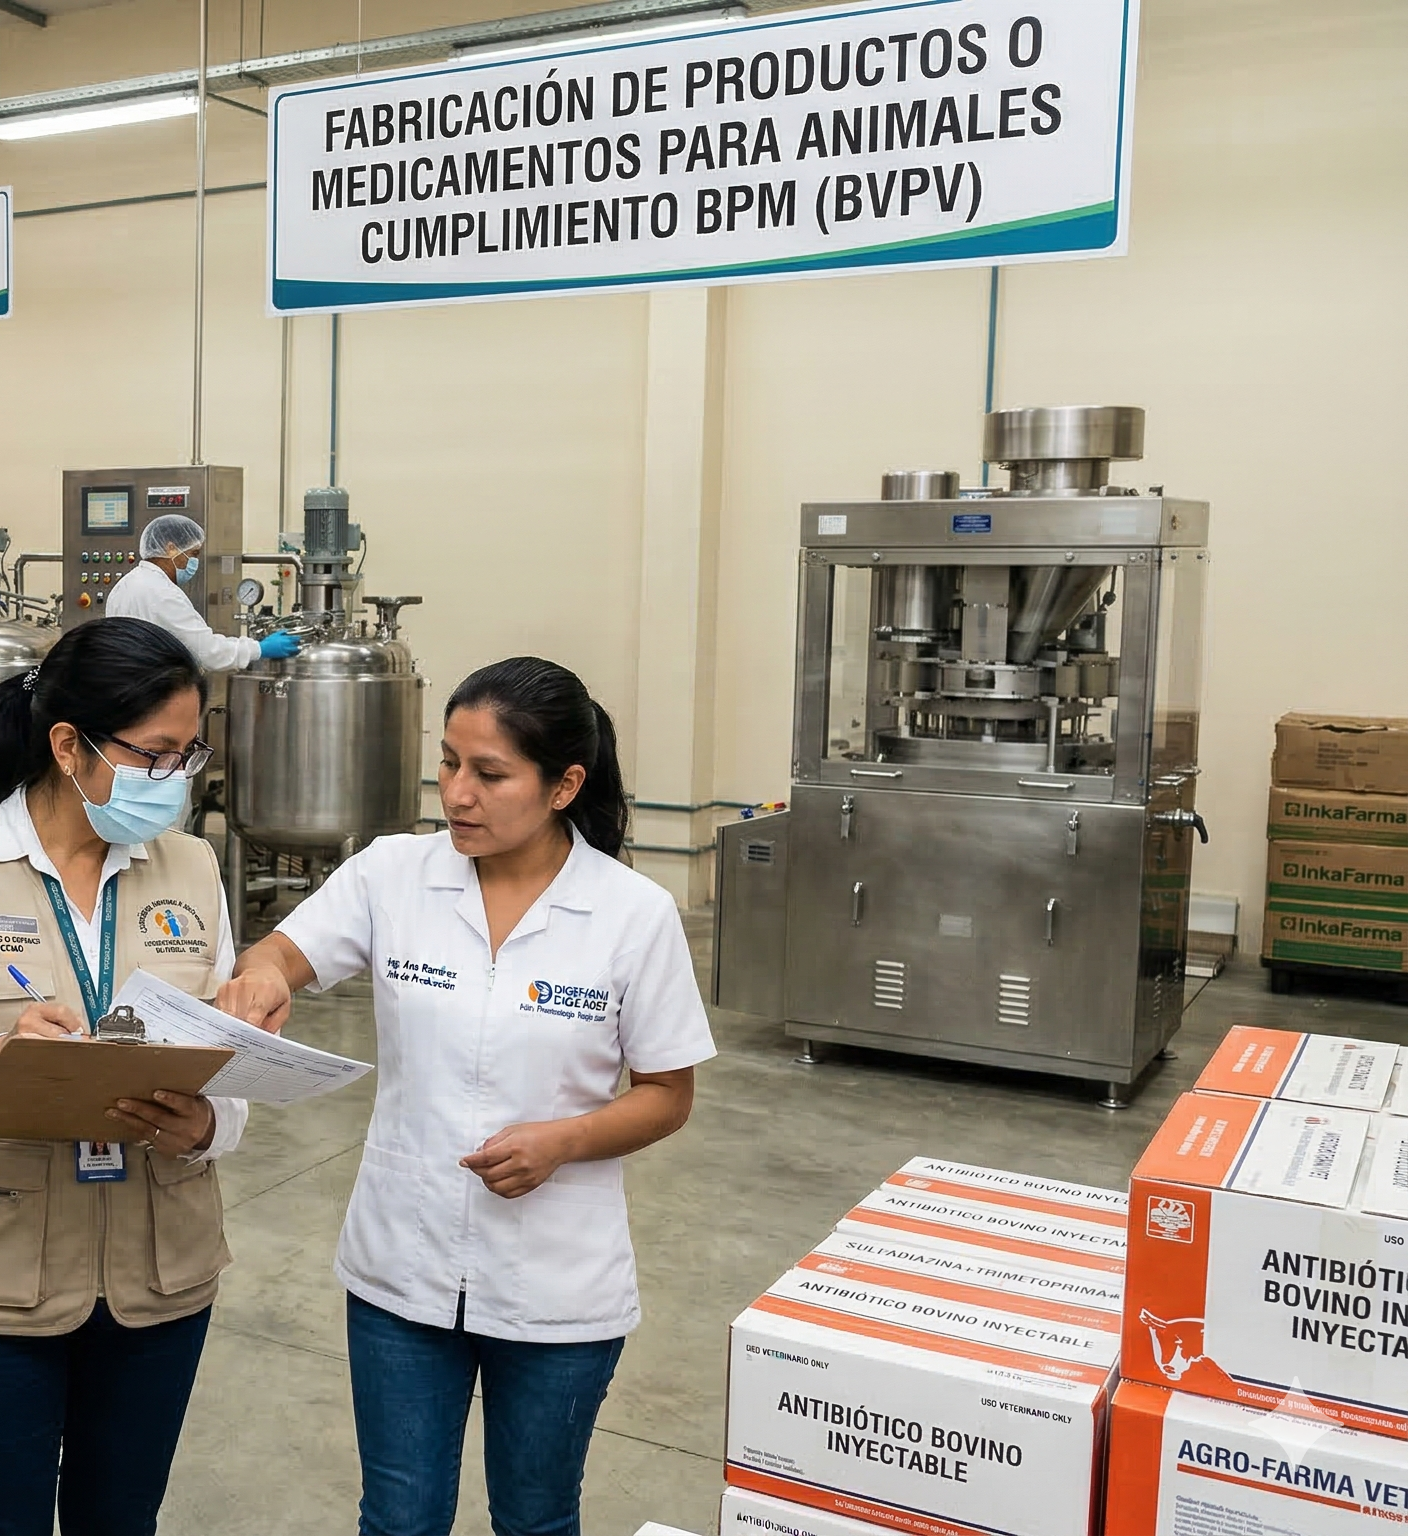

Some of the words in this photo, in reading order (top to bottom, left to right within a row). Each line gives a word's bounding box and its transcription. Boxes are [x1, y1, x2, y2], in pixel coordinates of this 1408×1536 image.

[325, 68, 593, 153] FABRICACIÓN
[612, 66, 668, 117] DE
[685, 23, 987, 108] PRODUCTOS
[1008, 16, 1043, 68] O
[312, 133, 640, 211] MEDICAMENTOS
[659, 117, 781, 175] PARA
[796, 83, 1062, 160] ANIMALES
[361, 192, 677, 264] CUMPLIMIENTO
[696, 180, 796, 234] BPM
[815, 161, 982, 235] (BVPV)
[1303, 803, 1407, 824] InkaFarma
[1301, 864, 1405, 887] InkaFarma
[1299, 918, 1402, 942] InkaFarma
[987, 1217, 1047, 1233] BOVINO
[1384, 1235, 1404, 1246] USO
[1261, 1249, 1408, 1294] ANTIBIÓTI
[799, 1281, 906, 1310] ANTIBIÓTICO
[912, 1305, 978, 1325] BOVINO
[983, 1320, 1095, 1349] INYECTABLE
[1264, 1279, 1371, 1320] BOVINO
[1292, 1316, 1408, 1360] INYECTA
[811, 1359, 829, 1369] ONLY
[981, 1397, 997, 1408] USO
[777, 1391, 923, 1443] ANTIBIÓTICO
[931, 1426, 1022, 1467] BOVINO
[827, 1430, 968, 1483] INYECTABLE
[1177, 1439, 1354, 1498] AGRO-FARMA
